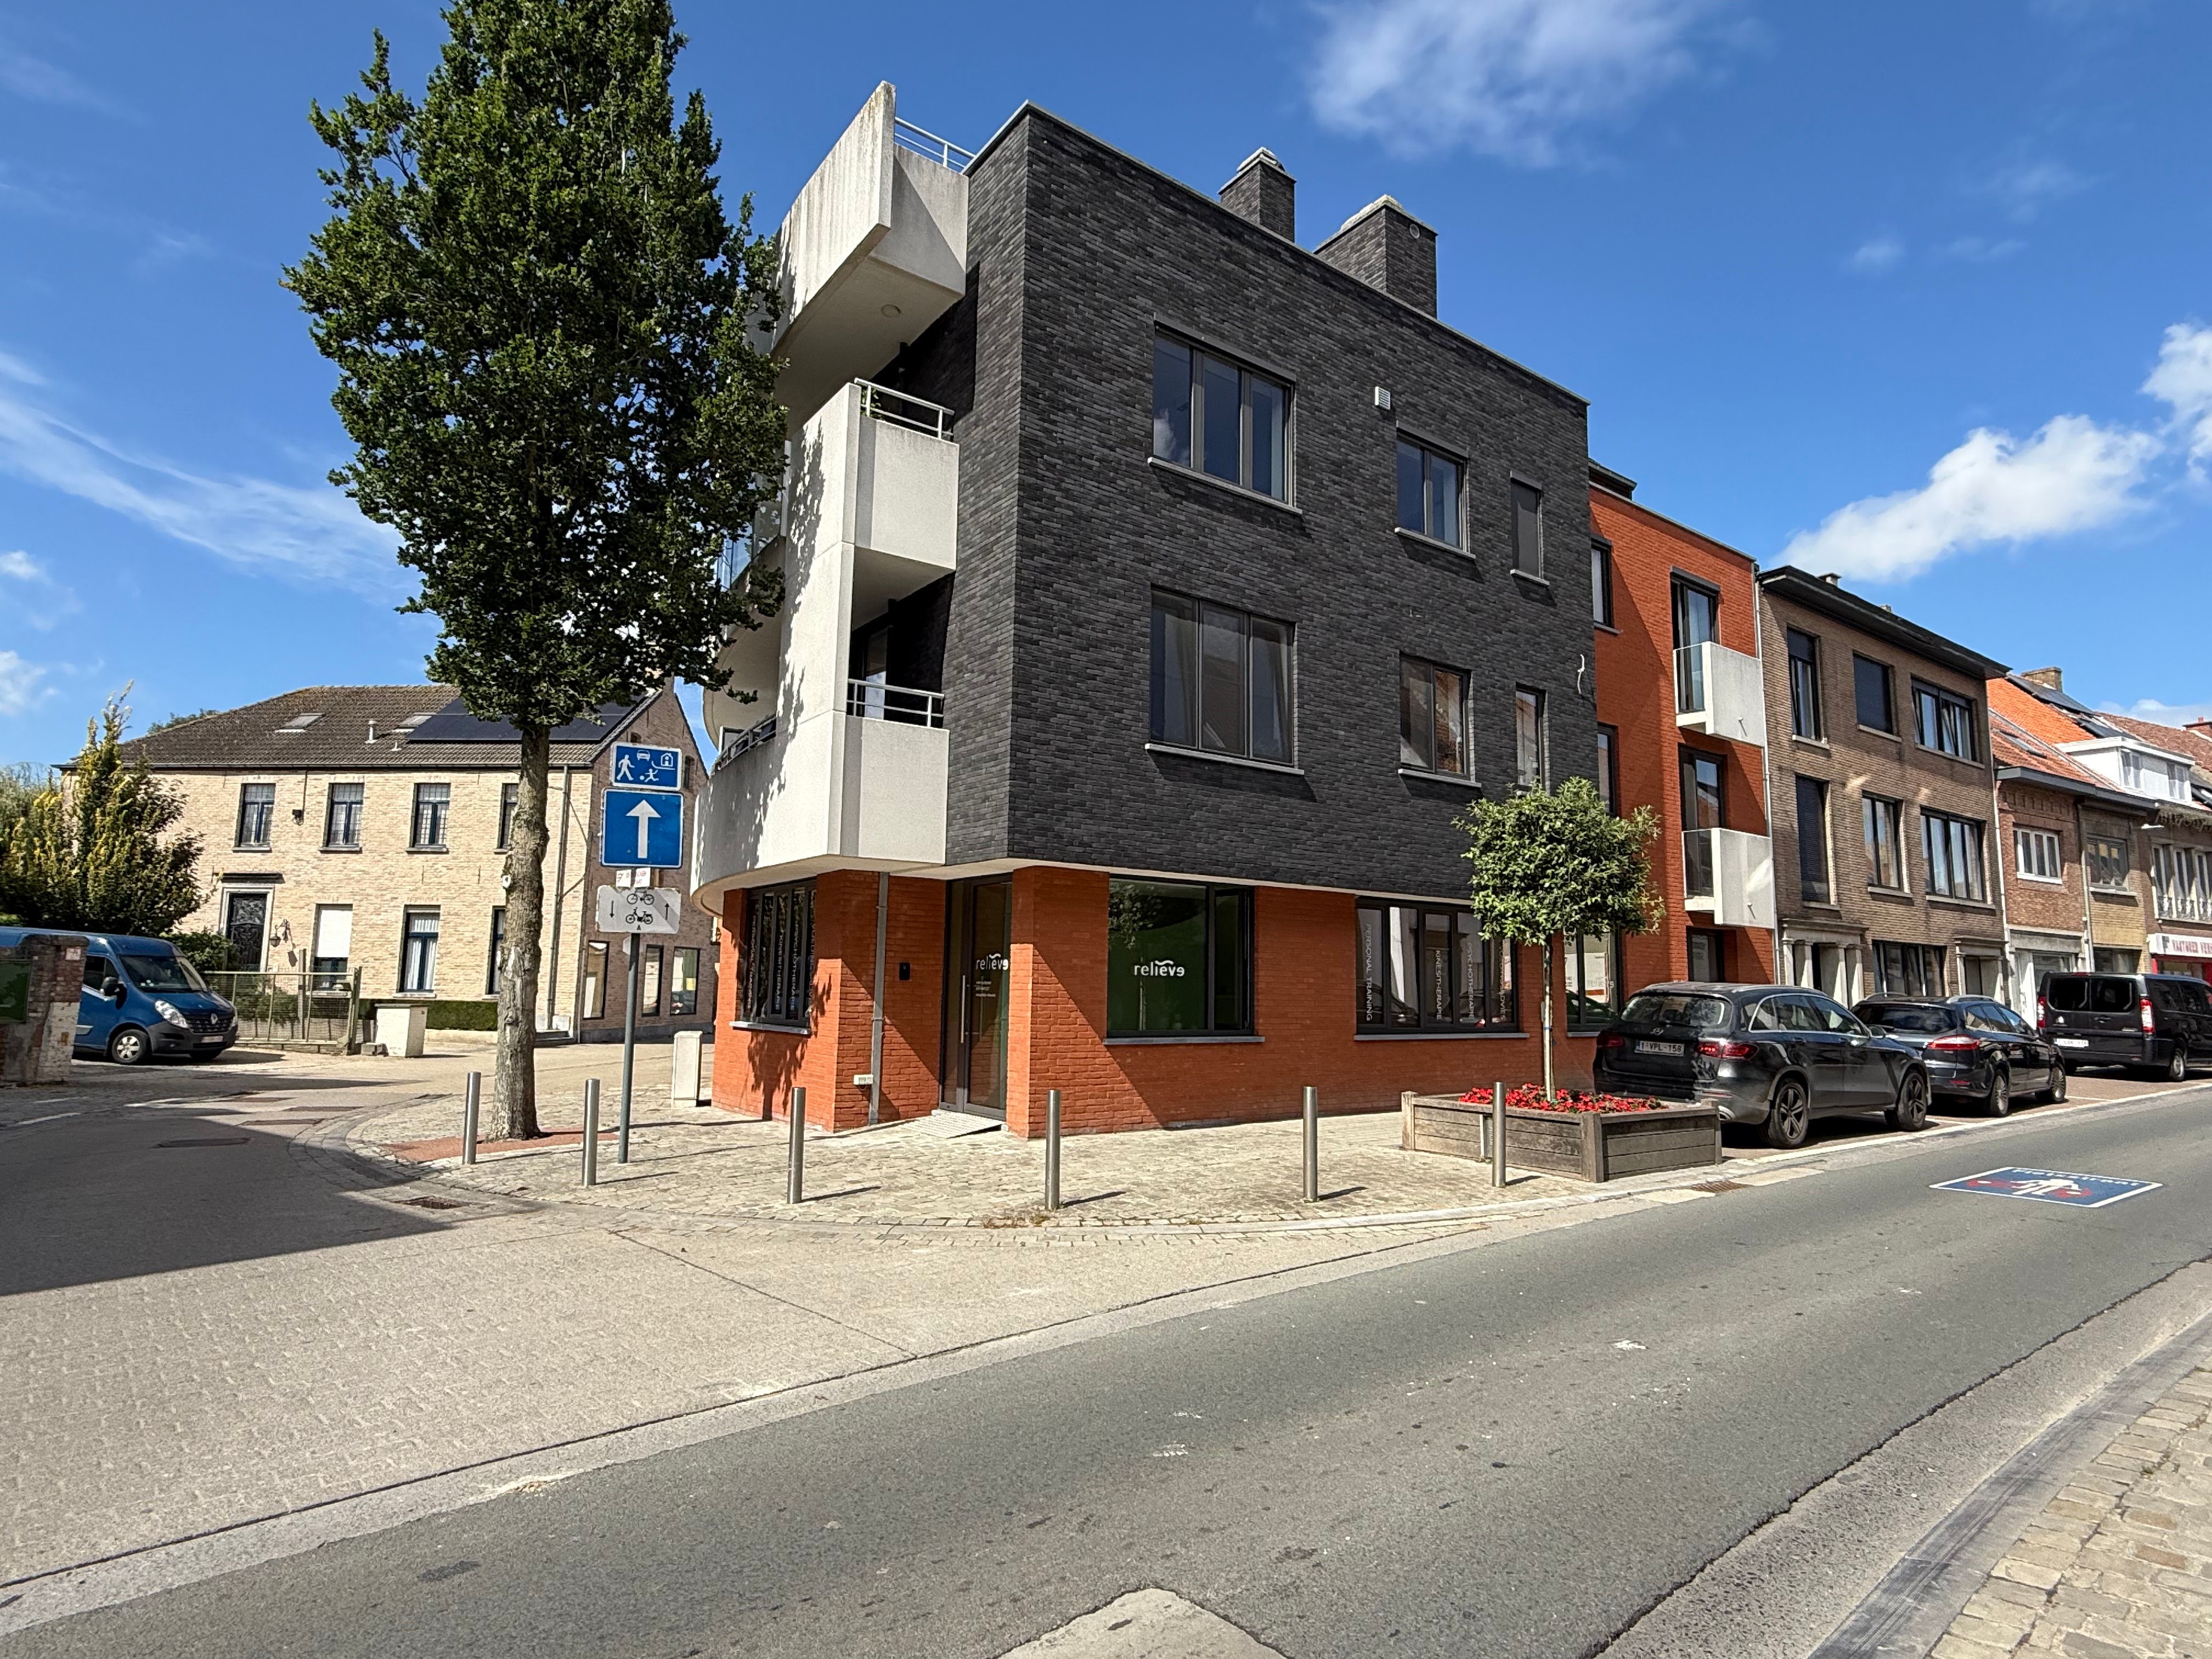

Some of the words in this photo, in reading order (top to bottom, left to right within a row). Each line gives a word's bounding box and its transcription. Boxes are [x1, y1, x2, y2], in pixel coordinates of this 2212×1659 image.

[975, 953, 1009, 970] relieve
[1134, 960, 1185, 977] relieve
[1466, 943, 1475, 1019] PSYCHOTHERAPIE
